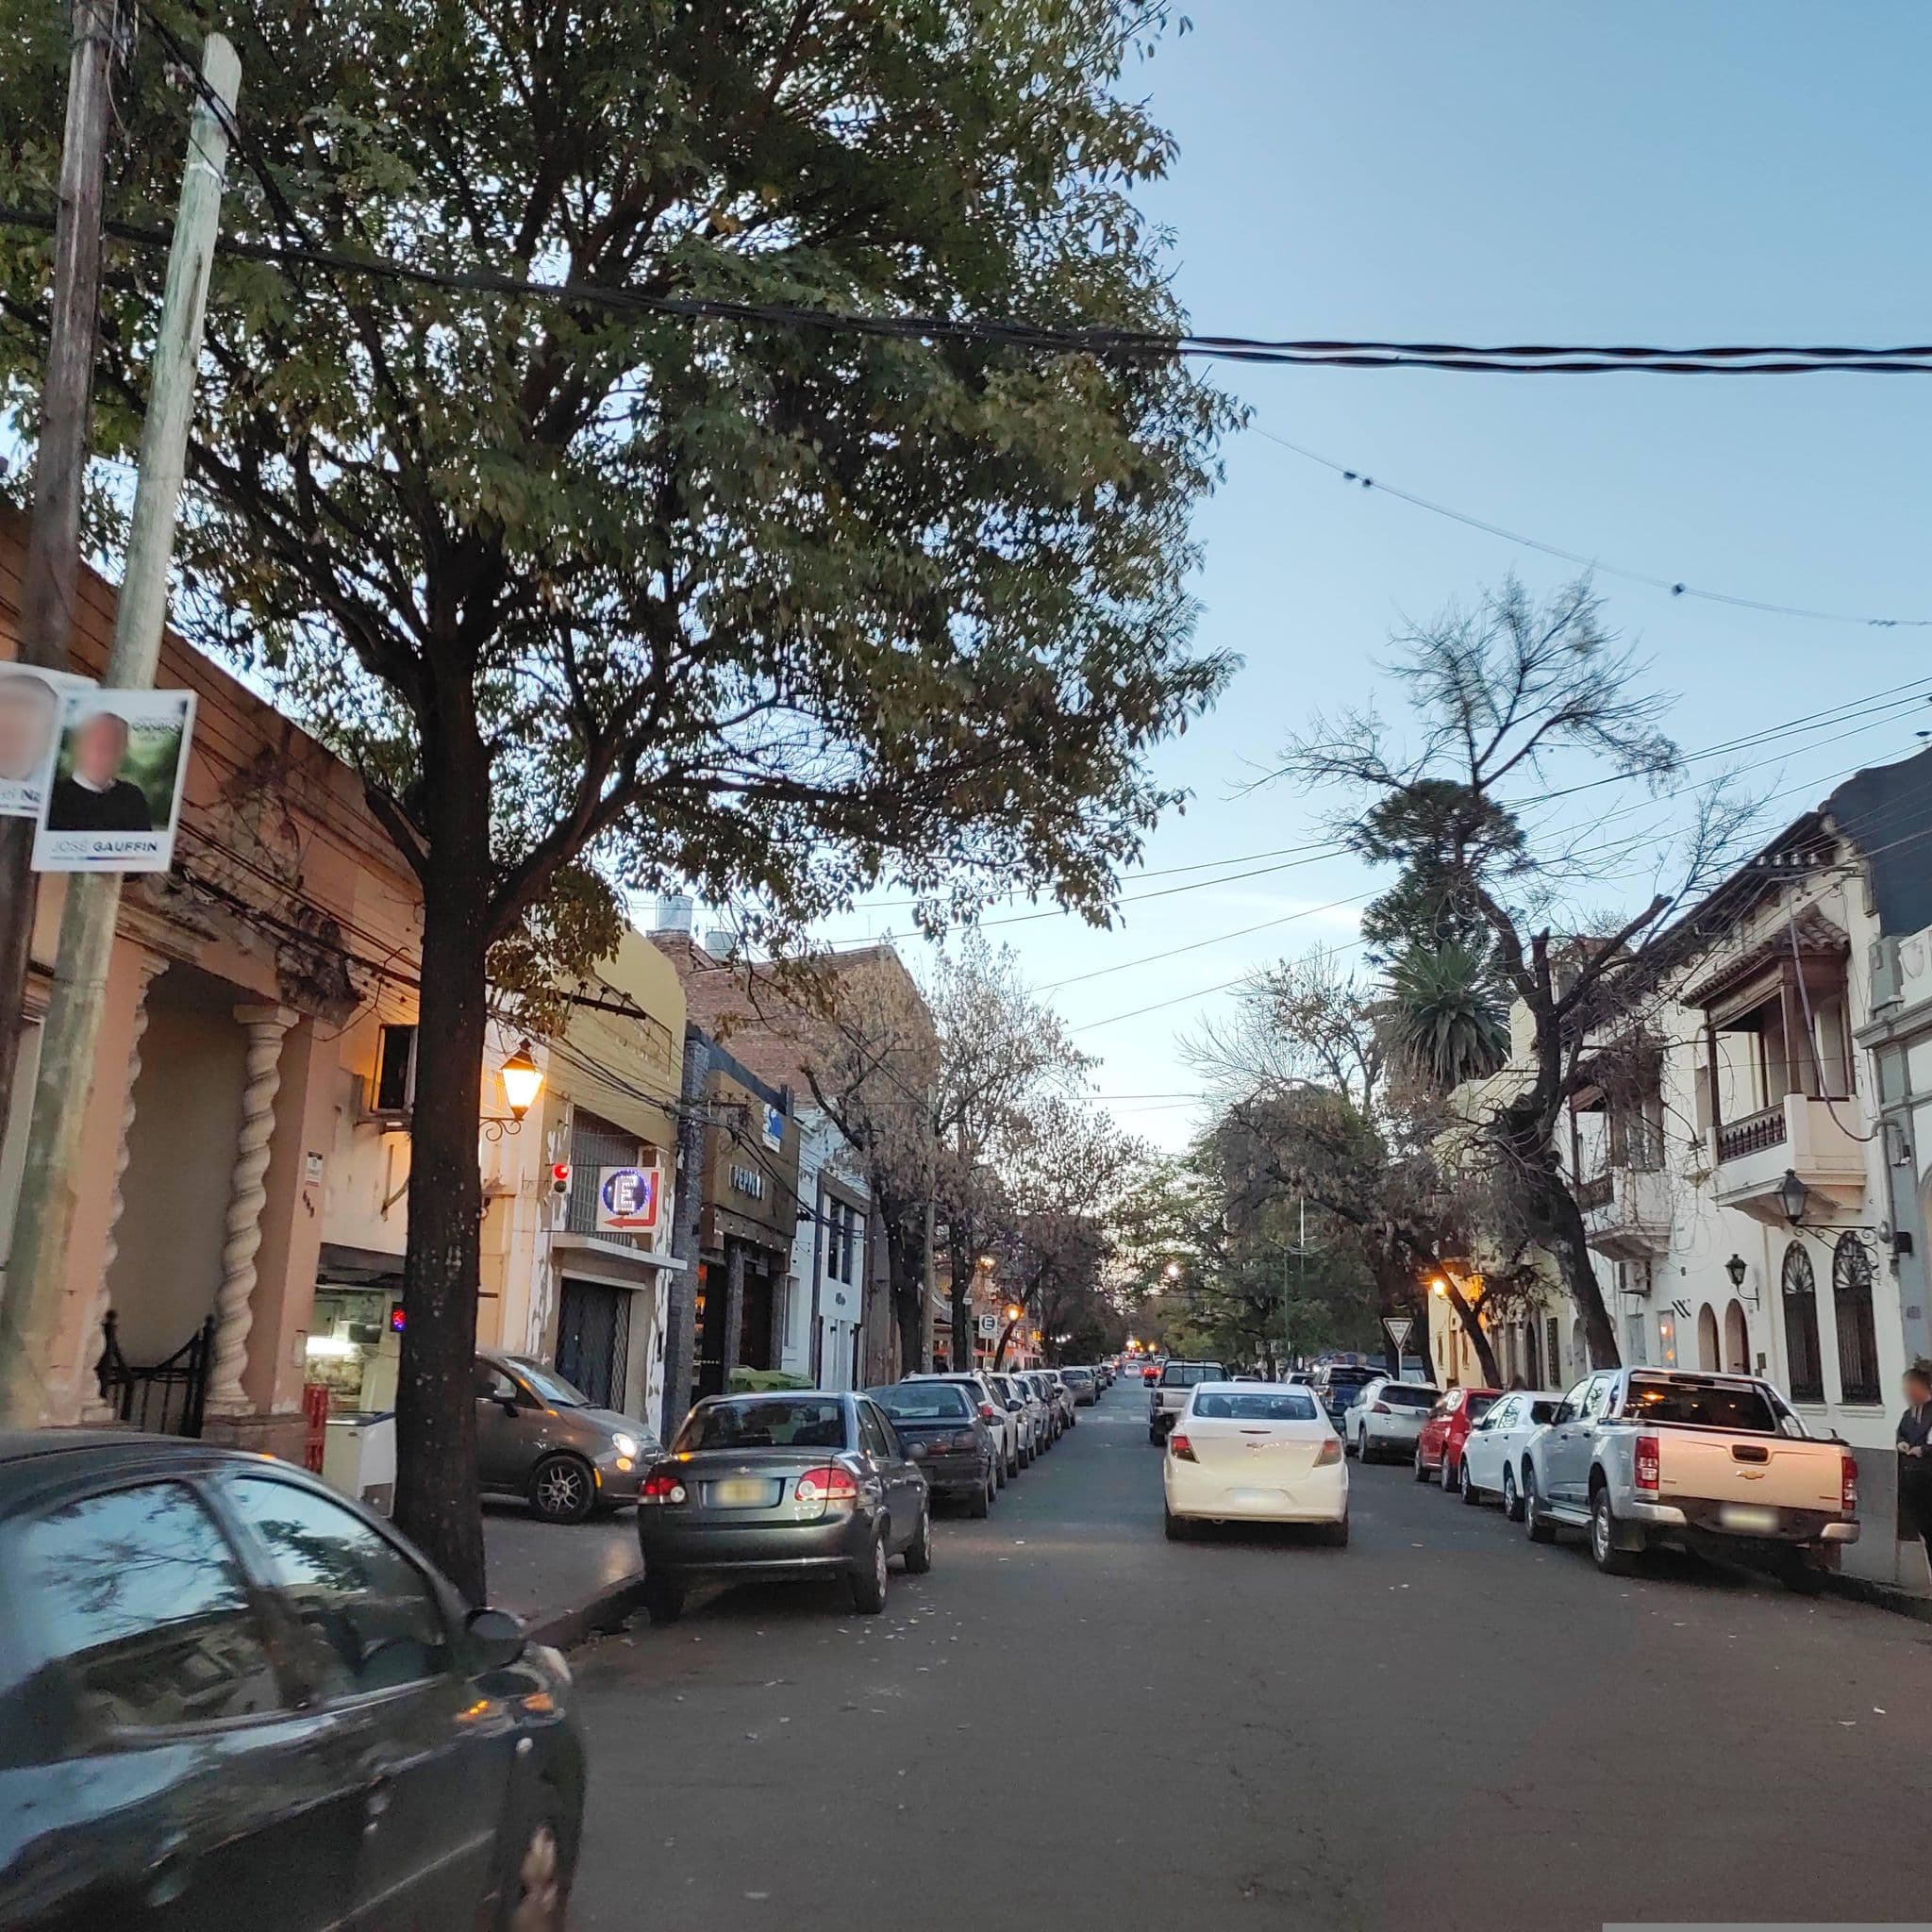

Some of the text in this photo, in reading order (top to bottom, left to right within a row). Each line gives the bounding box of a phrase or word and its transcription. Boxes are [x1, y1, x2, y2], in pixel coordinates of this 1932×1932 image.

[92, 841, 158, 852] GAUFFIN
[613, 1174, 640, 1212] E
[984, 1317, 993, 1329] E
